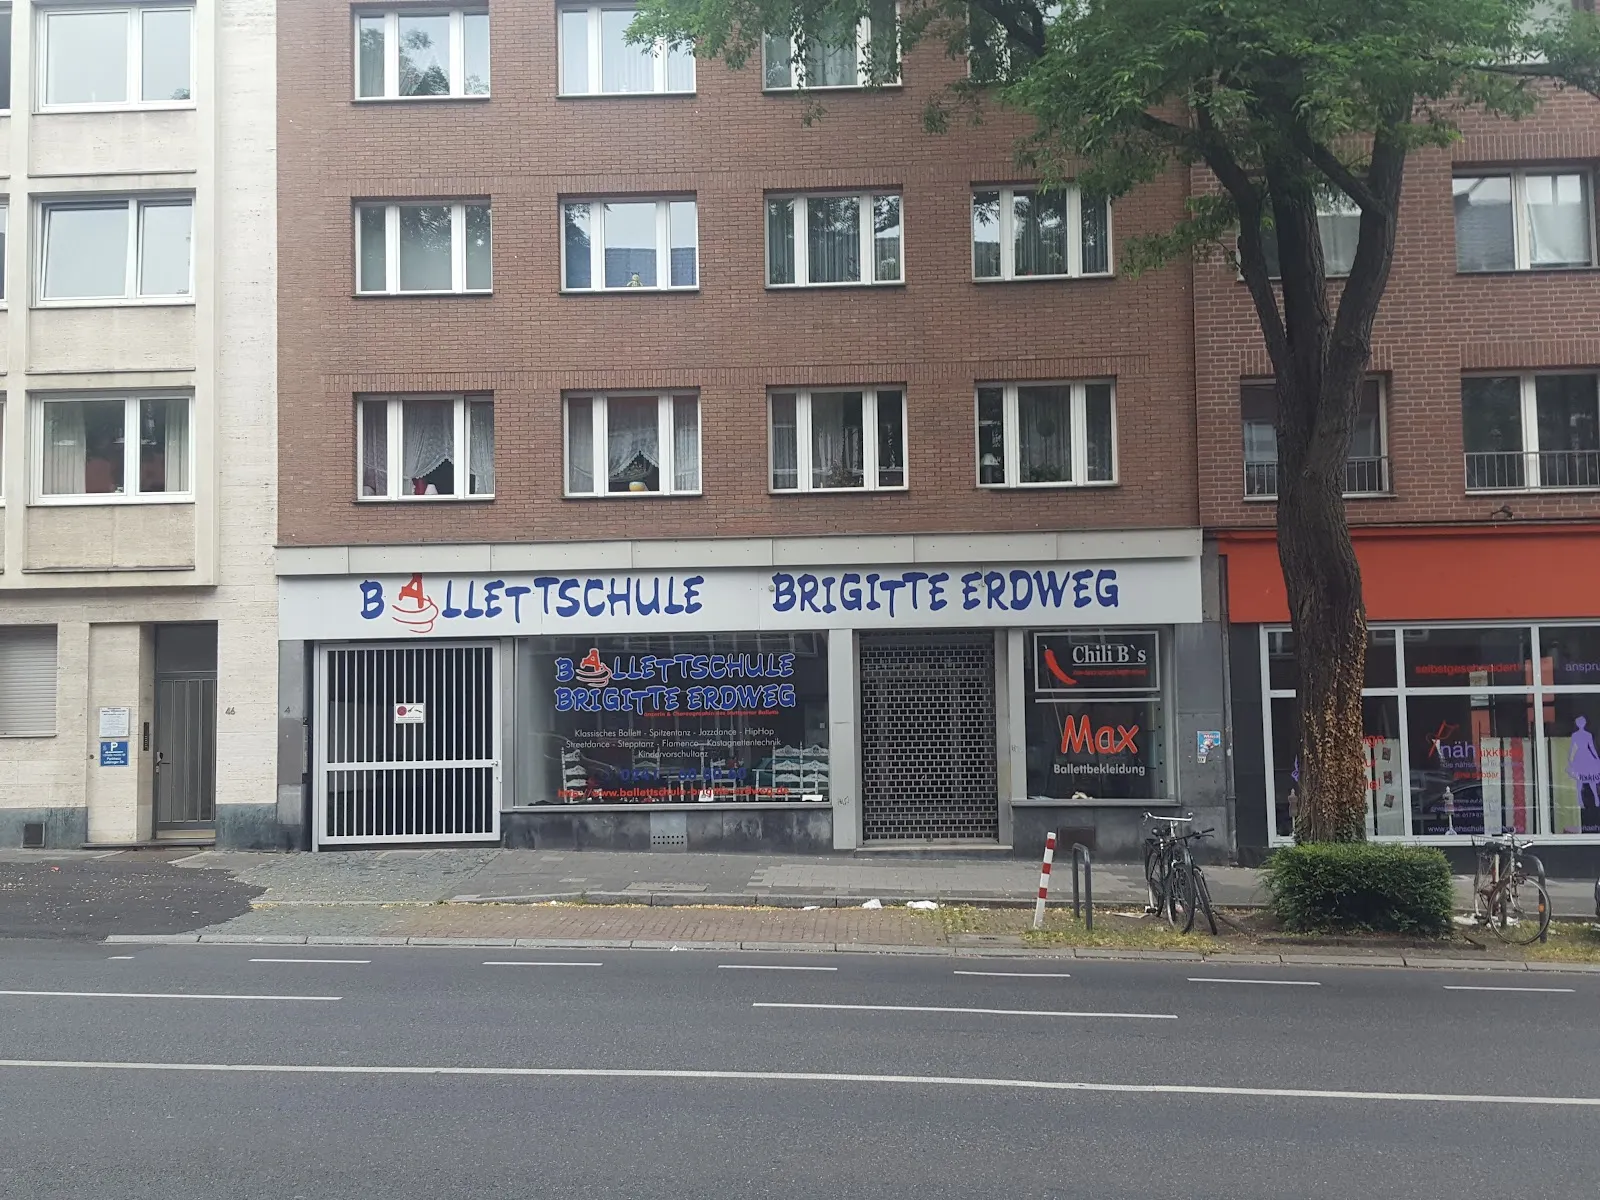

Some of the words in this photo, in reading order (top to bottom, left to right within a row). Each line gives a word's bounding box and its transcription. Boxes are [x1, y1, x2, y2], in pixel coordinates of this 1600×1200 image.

[360, 573, 704, 624] BALLETTSCHULE
[772, 572, 949, 617] BRIGITTE
[961, 569, 1119, 611] ERDWEG
[1072, 645, 1113, 663] Chili
[554, 648, 796, 682] BALLETTSCHULE
[554, 685, 680, 716] BRIGITTE
[686, 683, 796, 711] ERDWEG
[574, 729, 616, 738] Klassisches
[618, 729, 642, 738] Ballett
[649, 728, 691, 739] Spitzentanz
[698, 728, 737, 737] Jazzdance
[744, 728, 775, 738] HipHop
[1061, 714, 1139, 754] Max
[110, 742, 118, 752] P
[565, 740, 610, 748] Streetdance
[617, 740, 655, 750] Stepptanz
[662, 739, 698, 748] Flamenco
[706, 738, 781, 749] Kastagnettentechnik
[638, 749, 708, 758] Kindervorschultanz
[1053, 763, 1145, 776] Ballettbekleidung
